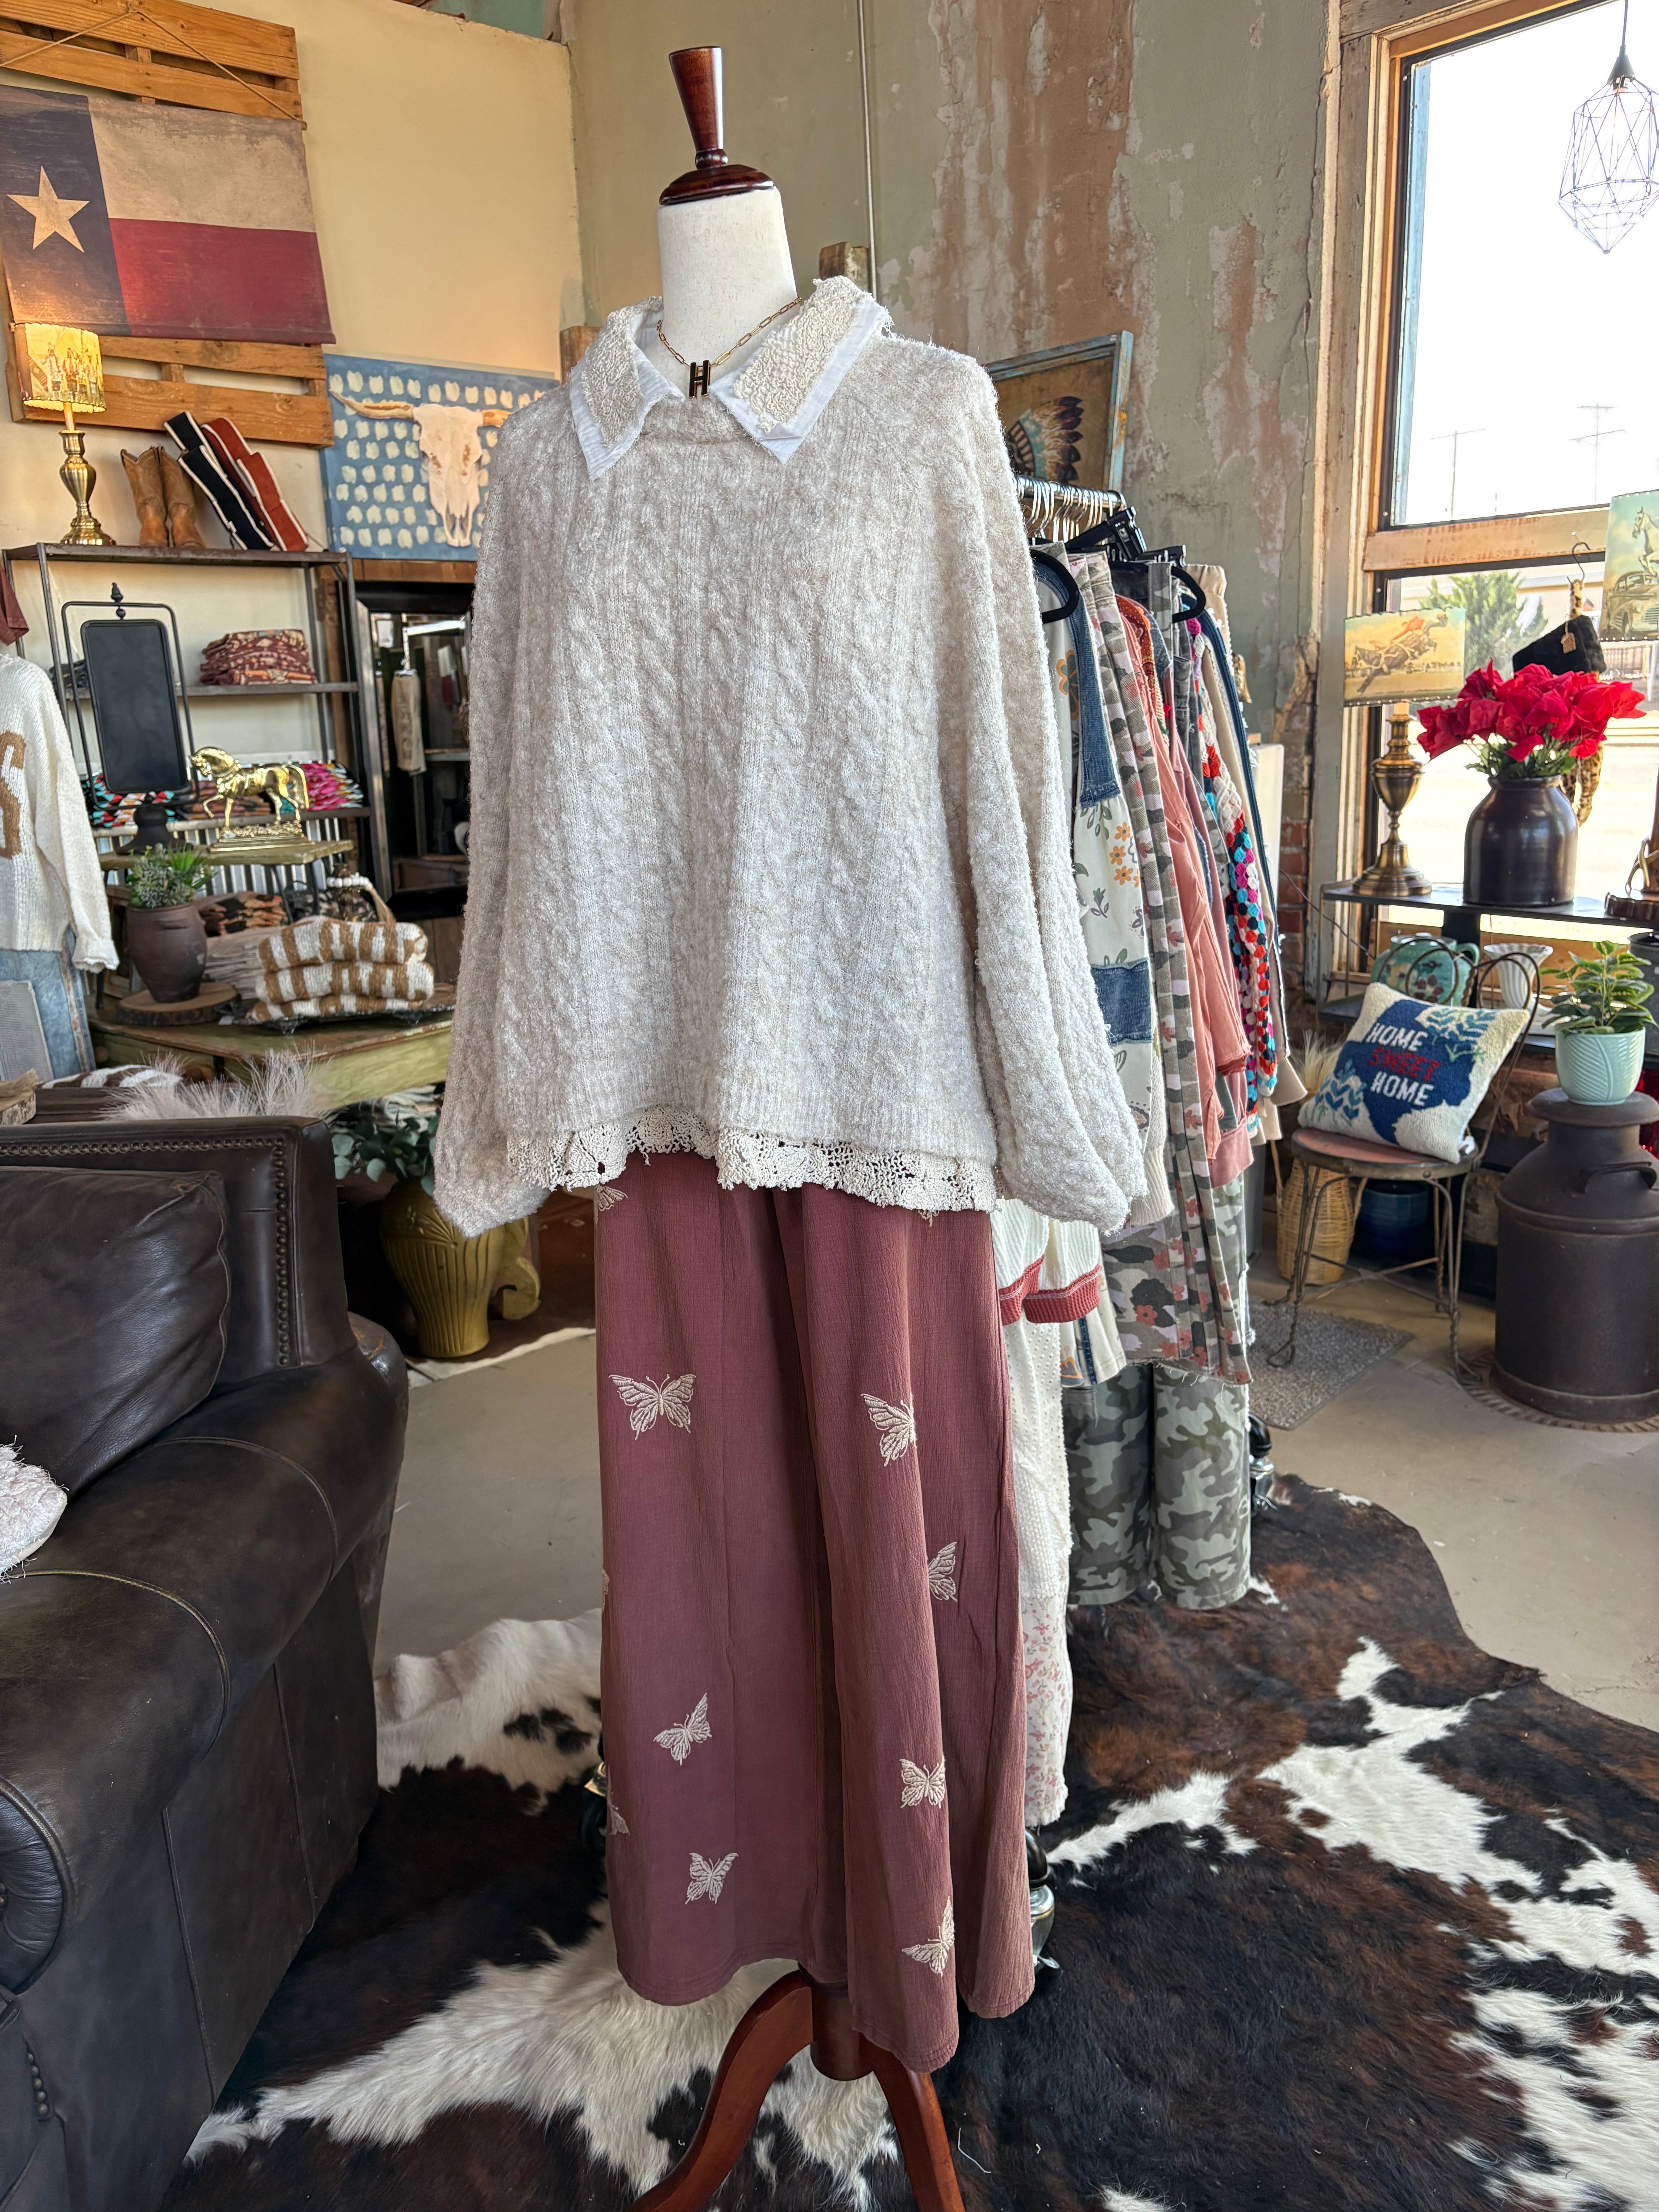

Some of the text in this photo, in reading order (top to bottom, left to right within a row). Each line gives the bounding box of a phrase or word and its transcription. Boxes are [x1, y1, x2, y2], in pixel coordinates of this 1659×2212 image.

[689, 360, 709, 399] H
[1366, 1022, 1428, 1052] HOME
[1369, 1047, 1442, 1082] SWEET
[1370, 1071, 1434, 1106] HOME
